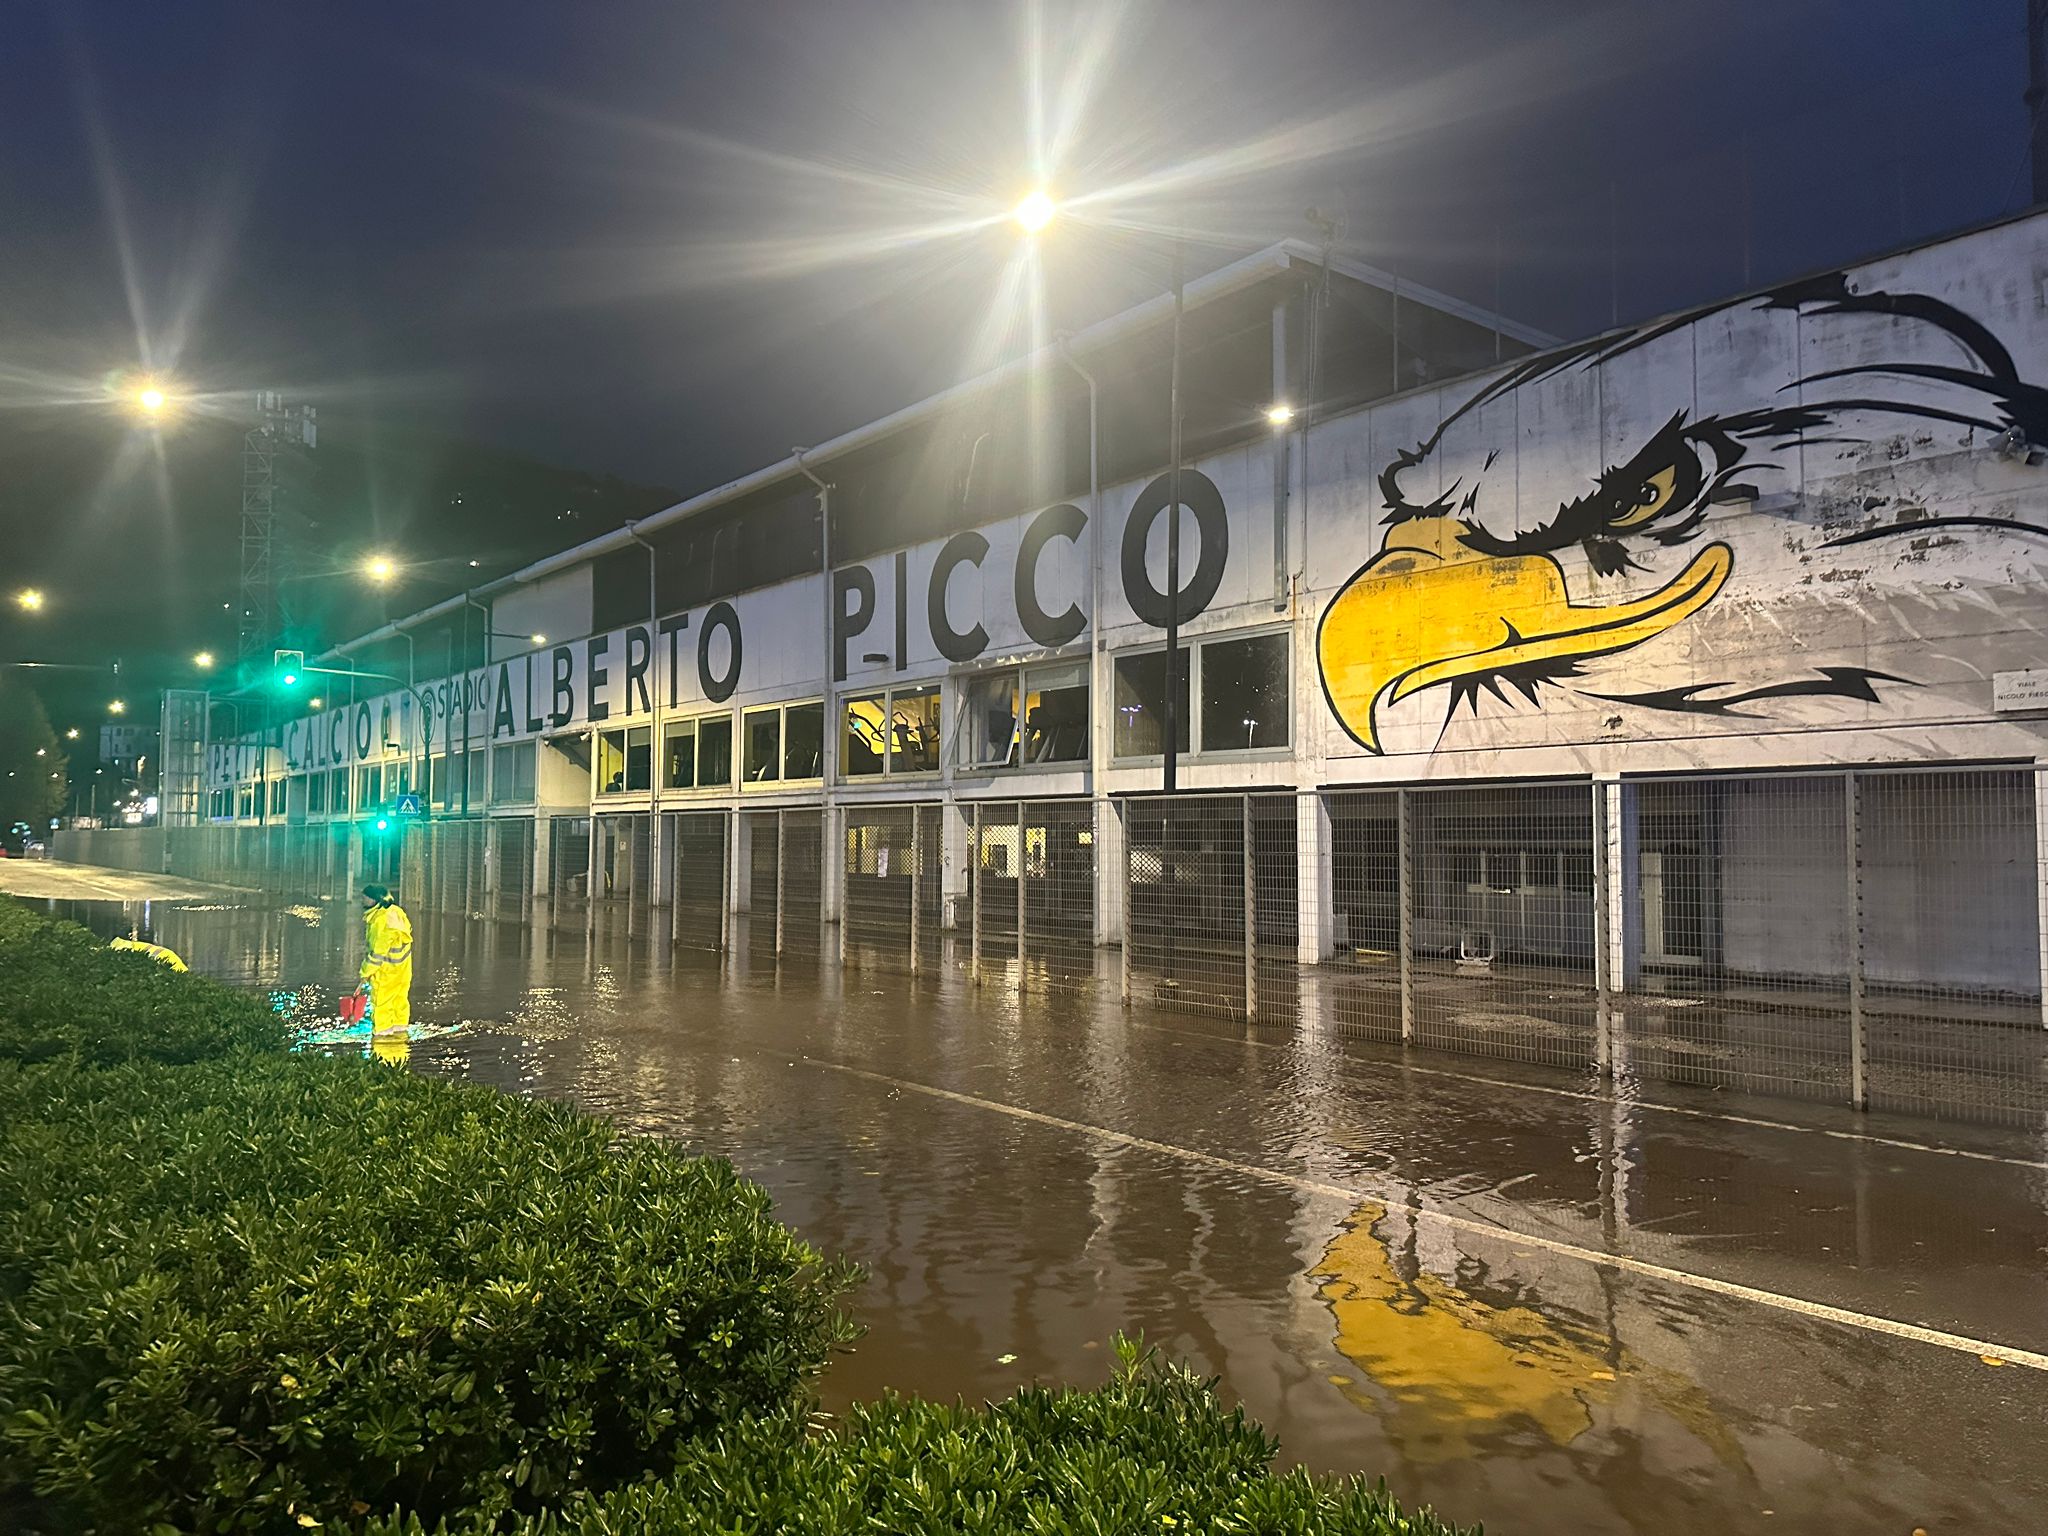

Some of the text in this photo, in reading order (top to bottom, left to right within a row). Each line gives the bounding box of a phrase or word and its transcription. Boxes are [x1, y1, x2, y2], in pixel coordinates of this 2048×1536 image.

[493, 601, 743, 738] ALBERTO
[833, 468, 1229, 682] PICCO
[287, 701, 371, 770] CALCIO
